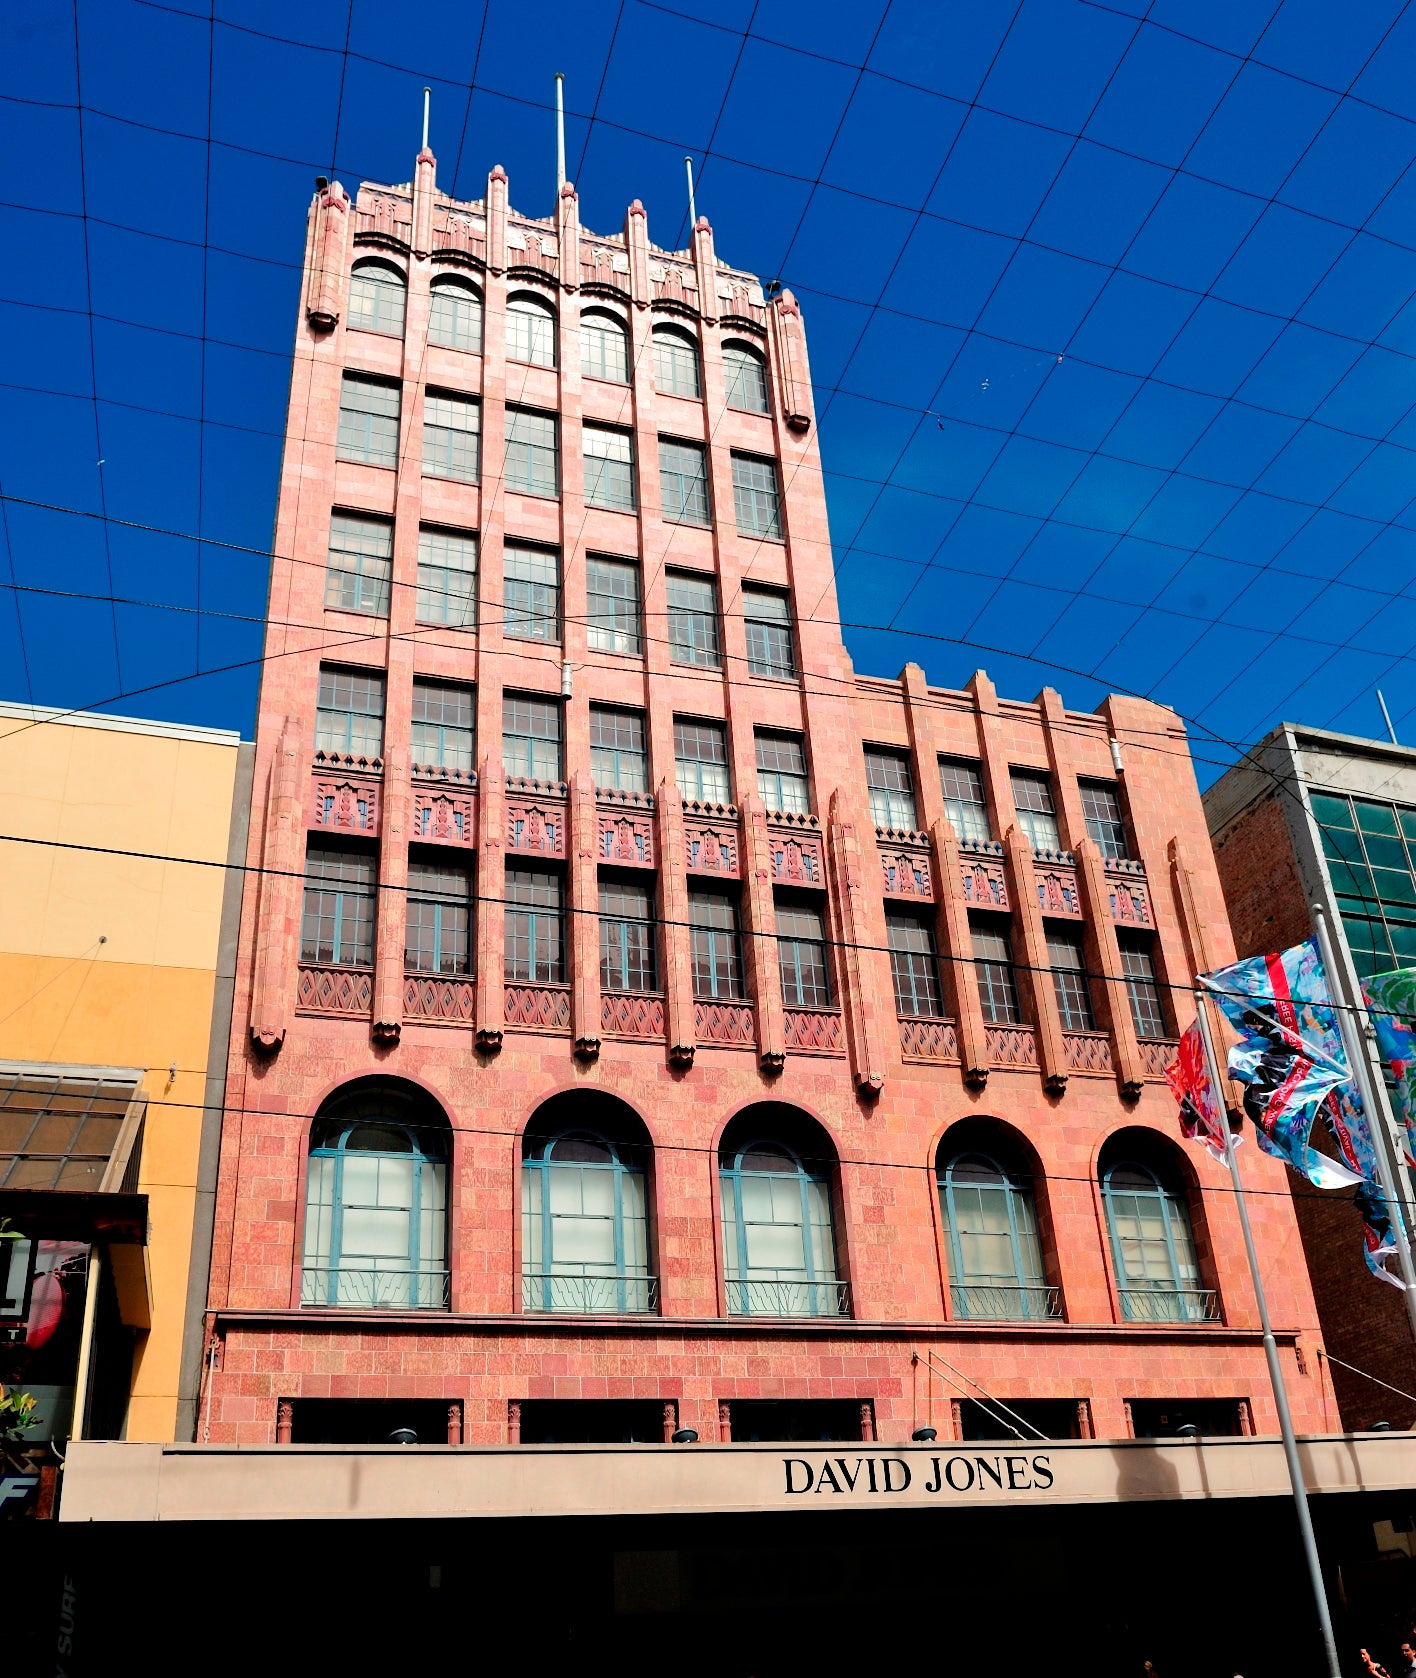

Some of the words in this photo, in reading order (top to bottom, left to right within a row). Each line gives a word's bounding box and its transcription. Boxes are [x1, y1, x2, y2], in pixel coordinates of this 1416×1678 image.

[782, 1457, 911, 1494] DAVID
[925, 1455, 1054, 1493] JONES
[57, 1575, 77, 1657] SURF
